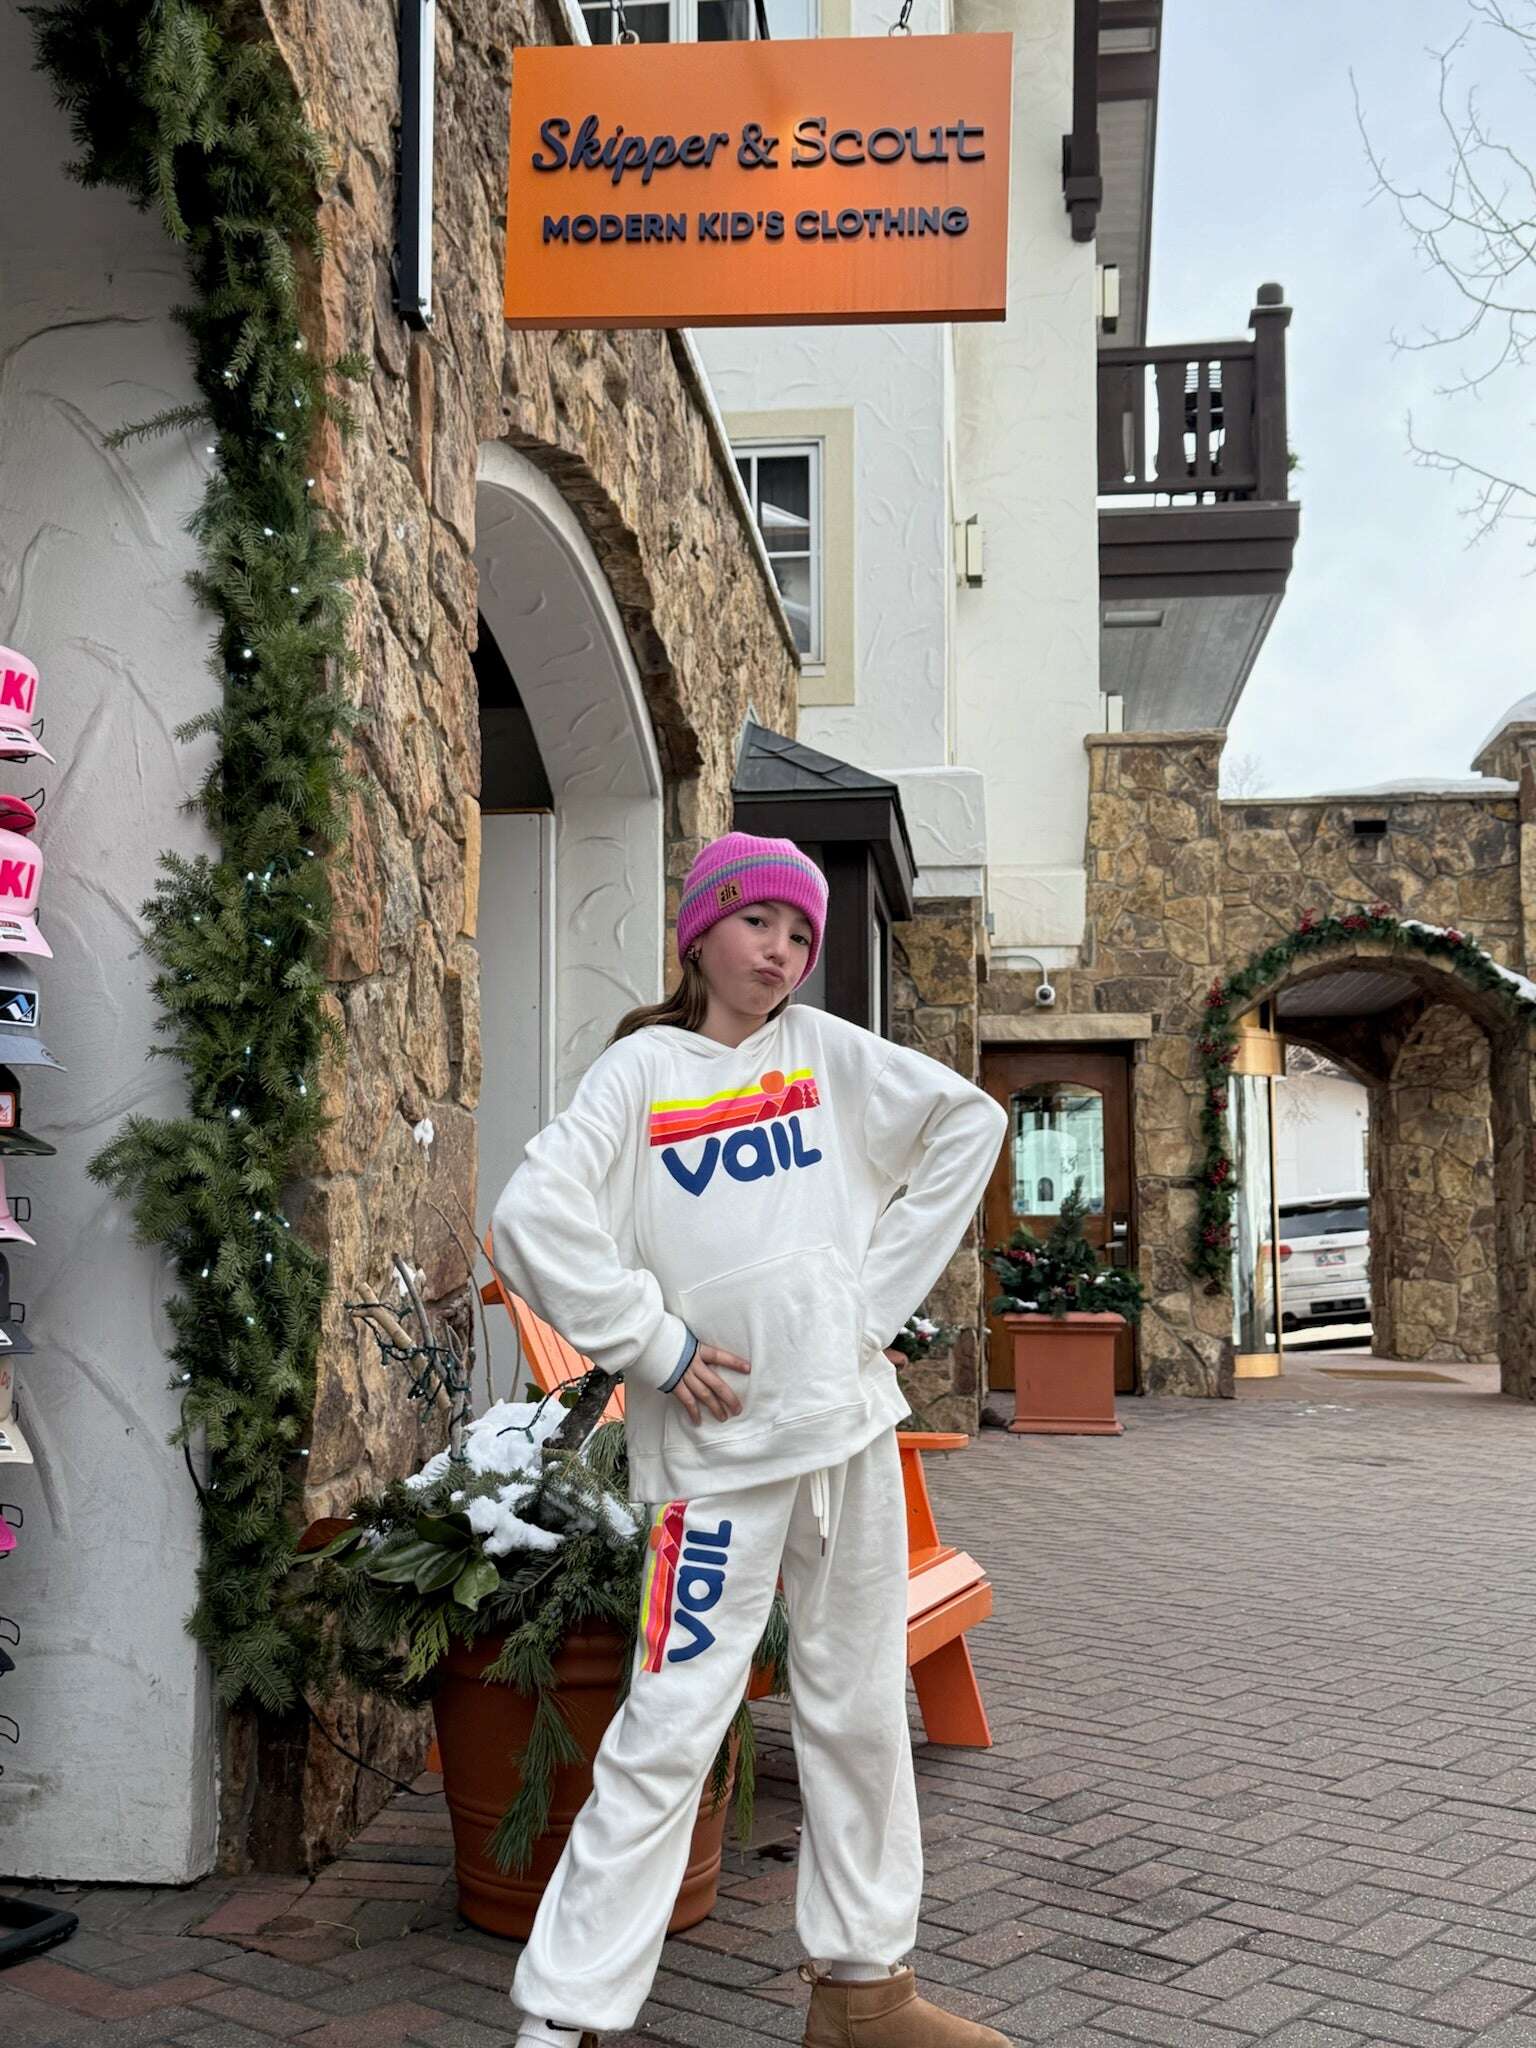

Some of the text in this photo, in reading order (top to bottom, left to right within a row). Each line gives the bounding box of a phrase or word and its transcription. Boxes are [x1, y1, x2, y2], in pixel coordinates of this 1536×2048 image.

[532, 115, 985, 185] Skipper & Scout
[542, 207, 970, 244] MODERN KID'S CLOTHING
